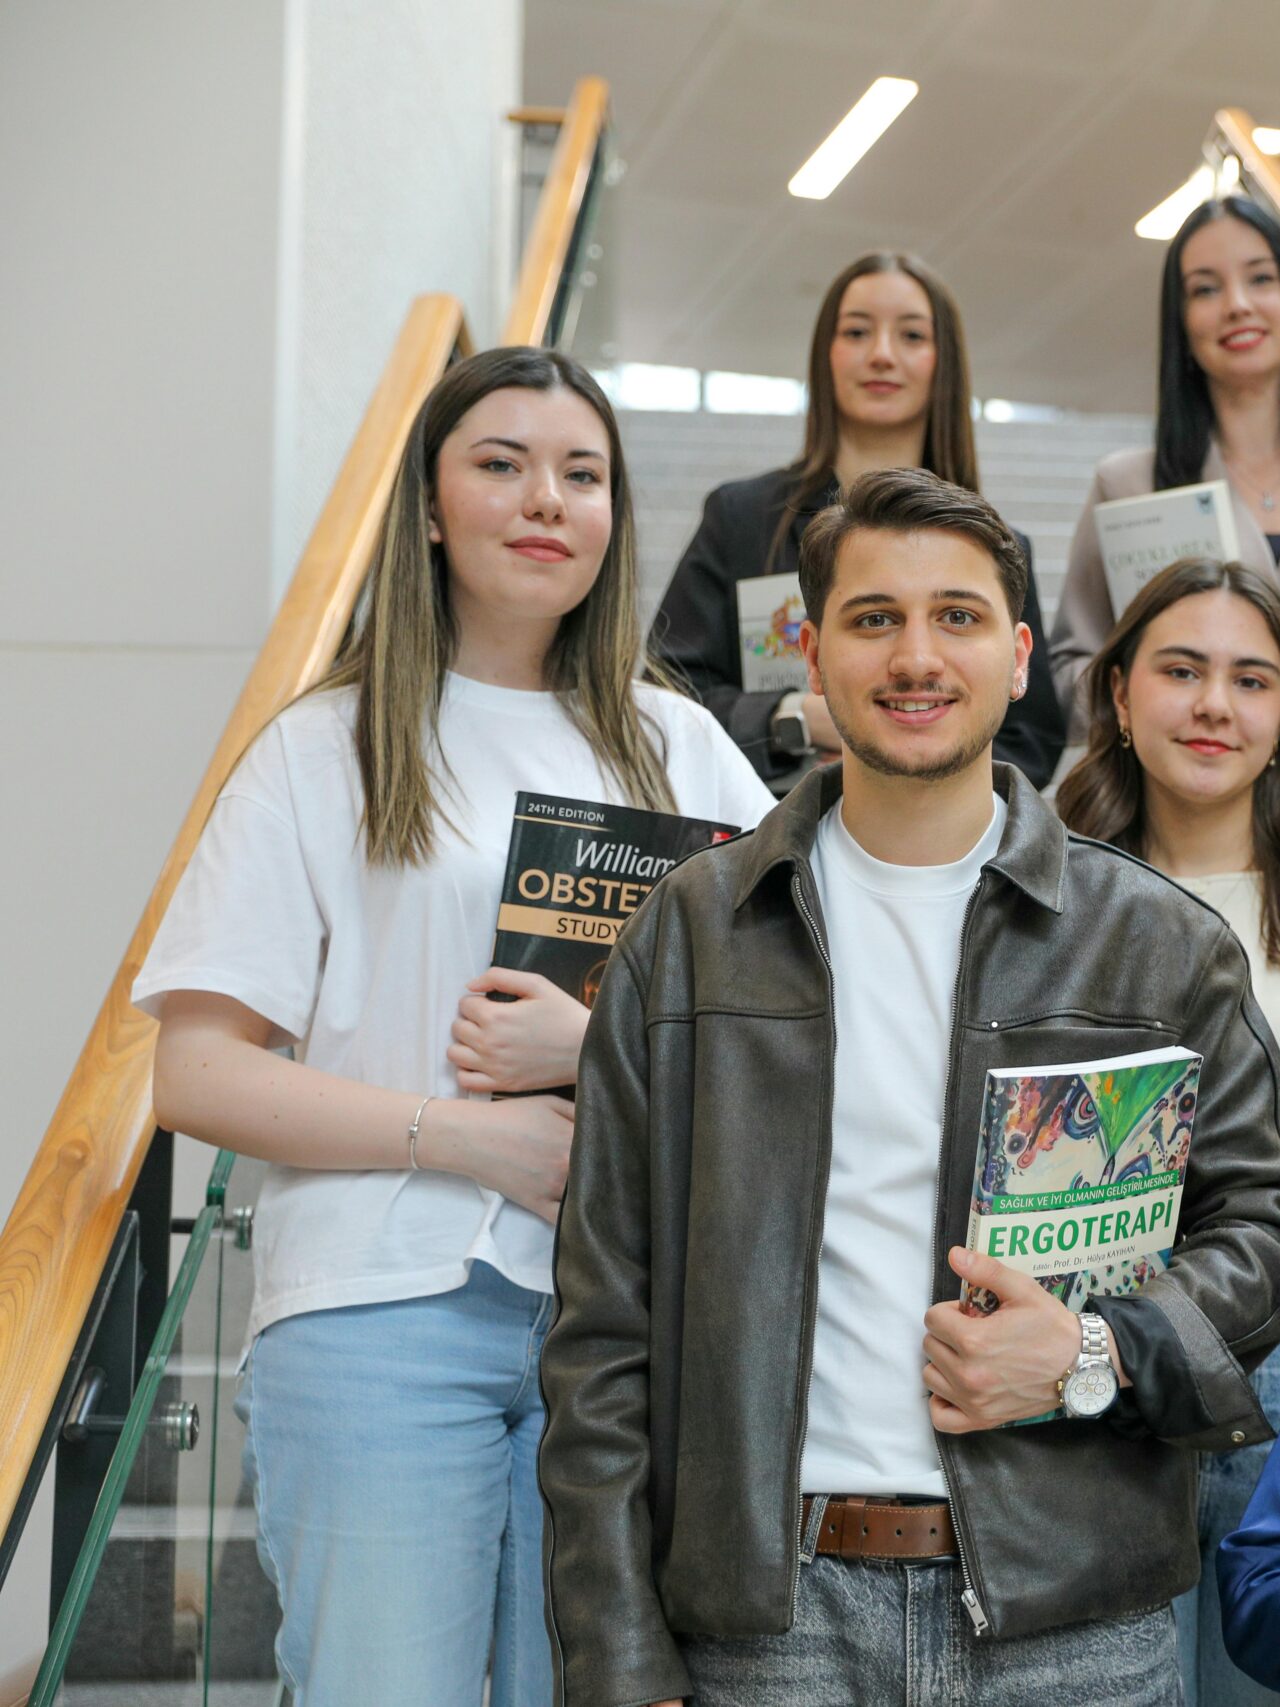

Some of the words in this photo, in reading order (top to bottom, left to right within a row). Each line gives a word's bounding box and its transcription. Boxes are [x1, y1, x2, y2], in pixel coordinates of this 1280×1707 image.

[528, 803, 555, 815] 24TH
[558, 807, 605, 823] EDITION
[575, 838, 677, 878] William
[999, 1196, 1034, 1209] SAĞLIK
[1037, 1196, 1049, 1207] VE
[1050, 1194, 1063, 1205] İYİ
[1064, 1188, 1105, 1204] OLMANIN
[1106, 1172, 1175, 1197] GELİŞTİRİLMESİNDE
[987, 1191, 1174, 1257] ERGOTERAPİ
[1053, 1258, 1072, 1269] Prof.
[1073, 1257, 1085, 1265] Dr.
[1107, 1245, 1136, 1259] KAYIHAN
